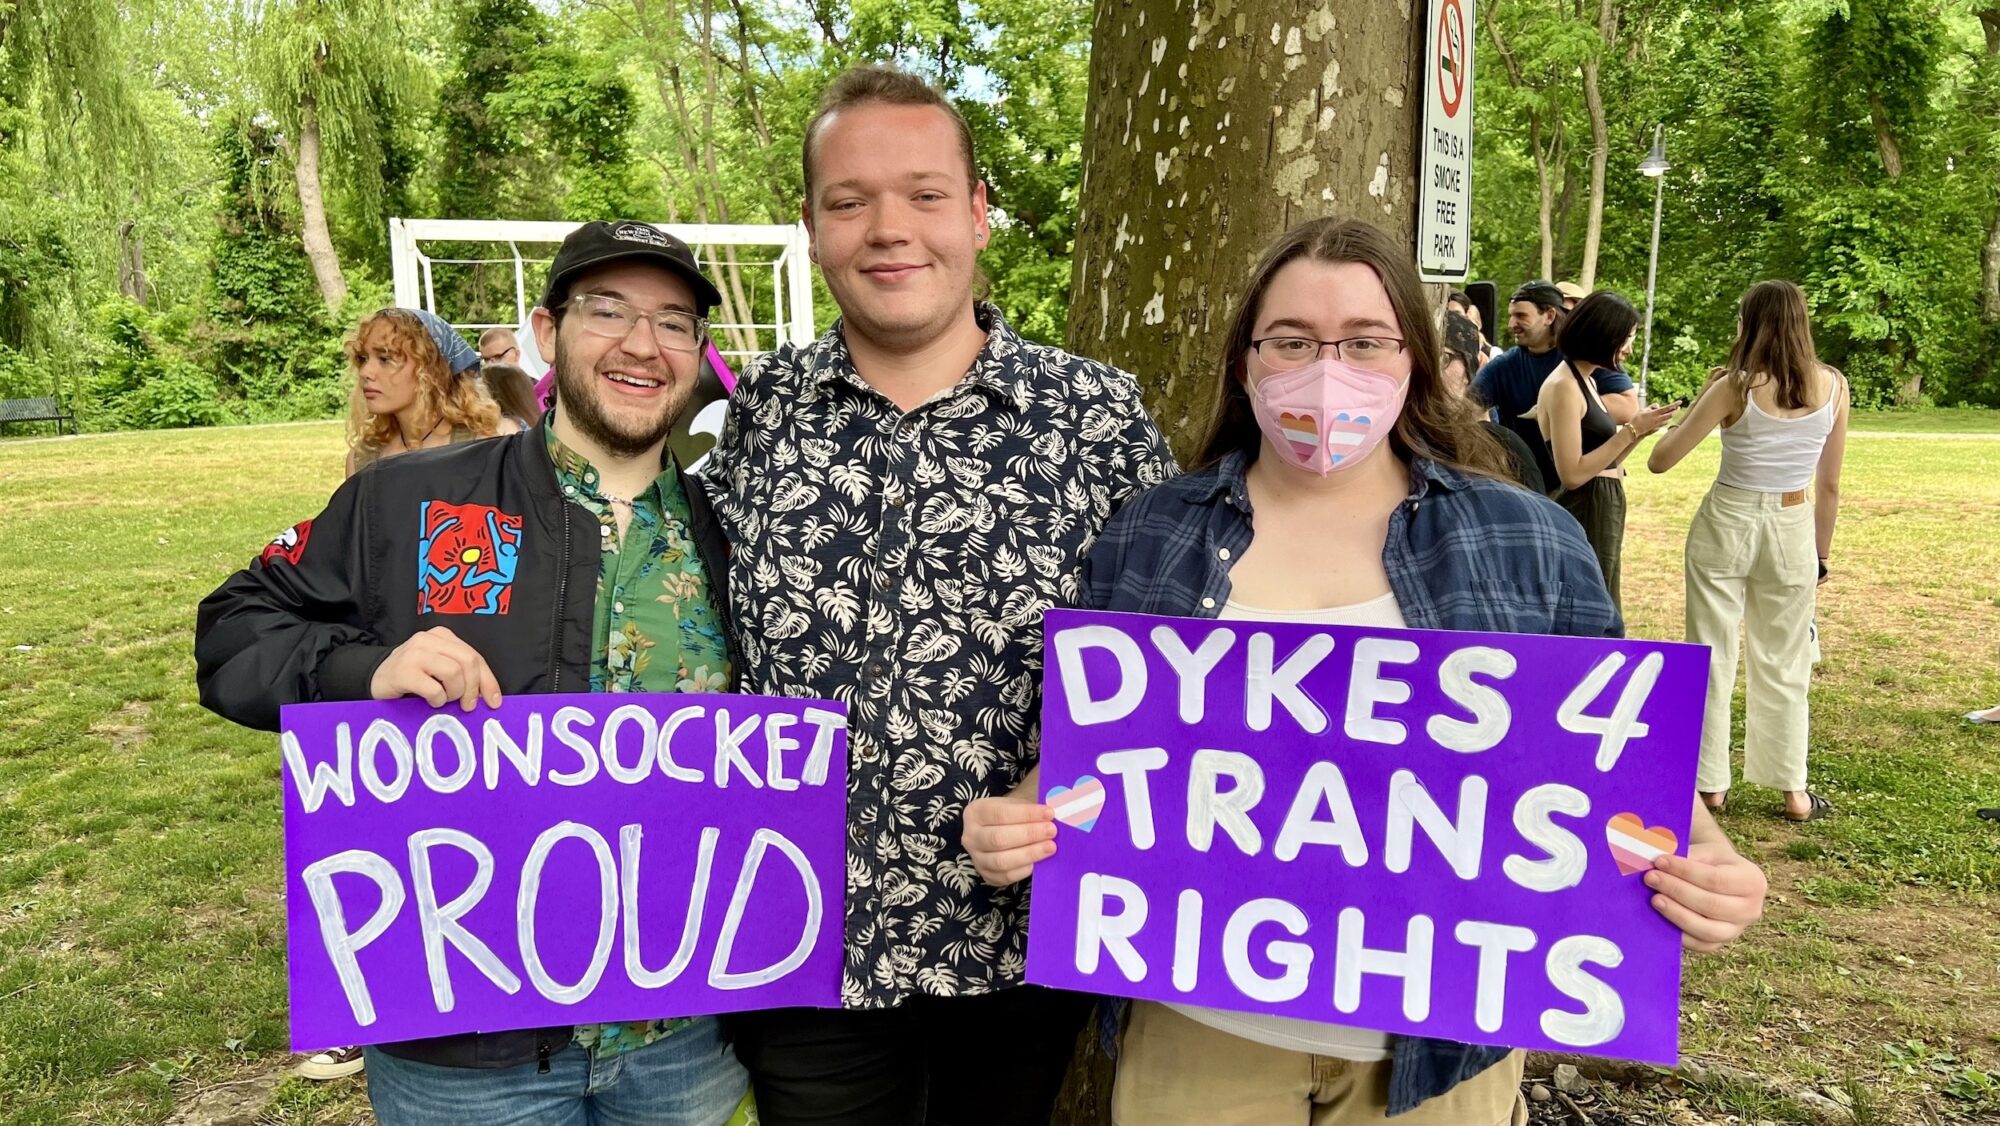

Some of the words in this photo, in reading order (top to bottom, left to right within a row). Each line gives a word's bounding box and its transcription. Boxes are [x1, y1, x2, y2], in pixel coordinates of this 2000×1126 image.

[1433, 127, 1449, 155] THIS
[1450, 134, 1458, 158] IS
[1459, 137, 1464, 160] A
[1434, 163, 1460, 192] SMOKE
[1433, 233, 1456, 258] PARK
[1436, 199, 1456, 225] FREE
[1053, 624, 1518, 753] DYKES
[1556, 651, 1664, 772] 4
[283, 704, 847, 813] WOONSOCKET
[1096, 747, 1591, 892] TRANS
[302, 820, 824, 1026] PROUD
[1075, 872, 1625, 1047] RIGHTS
